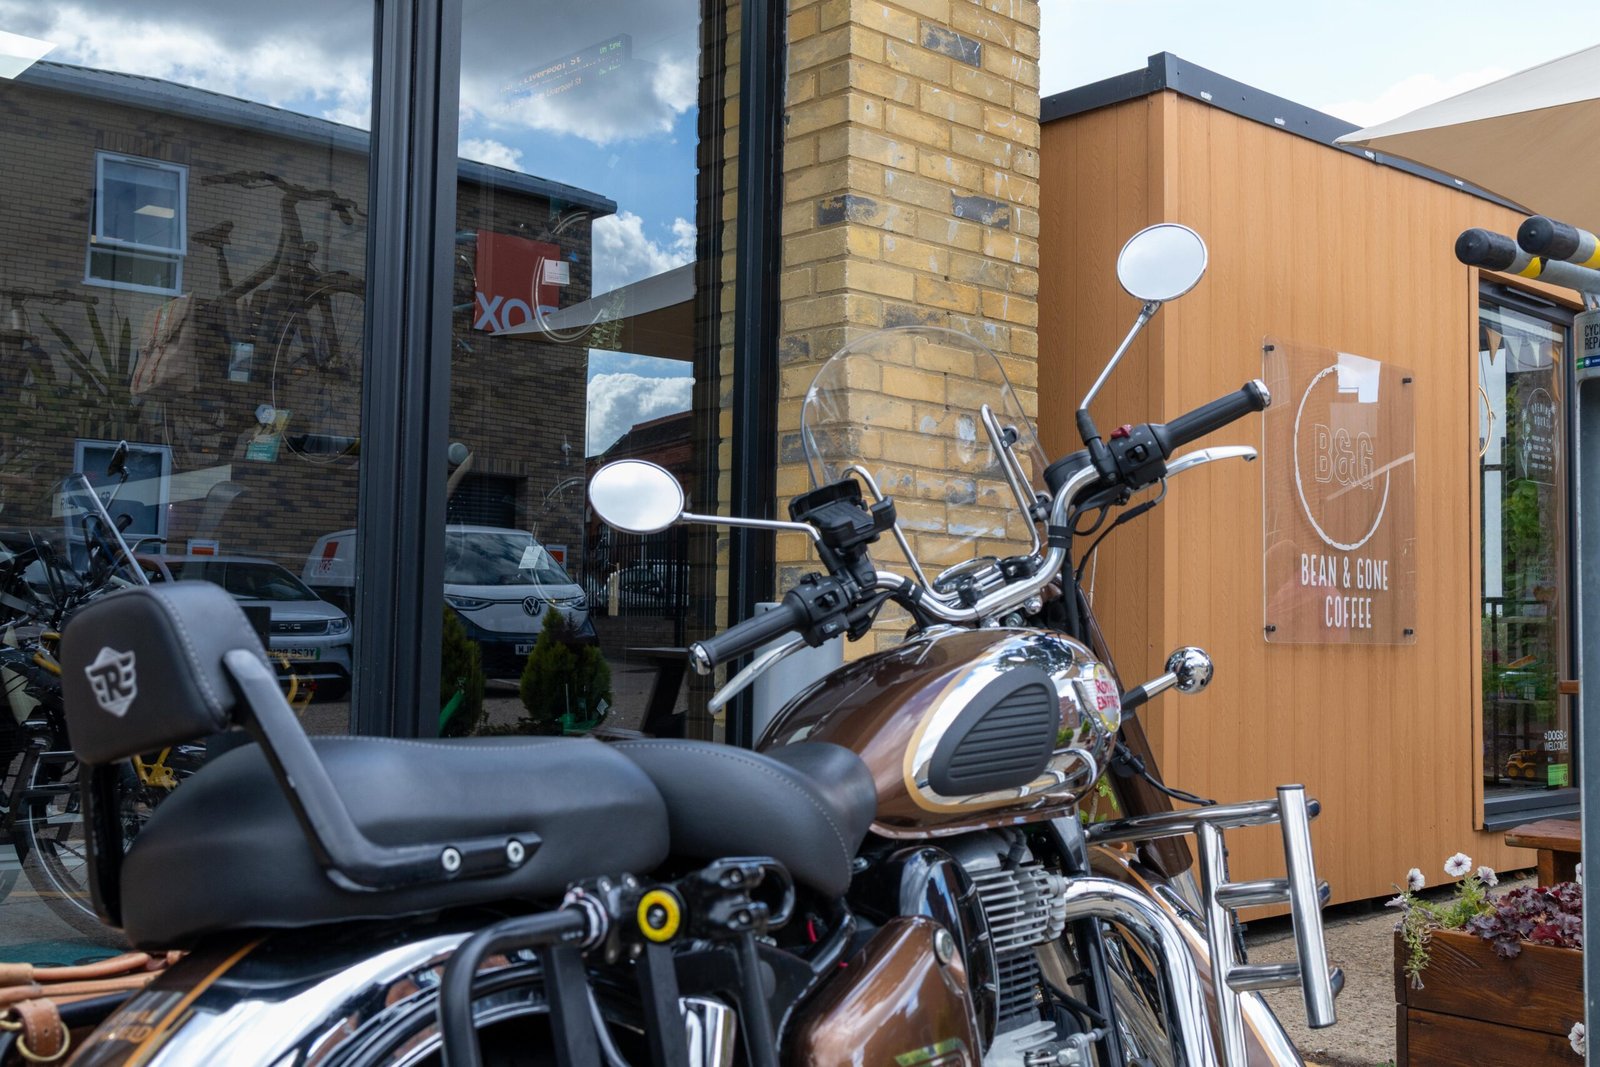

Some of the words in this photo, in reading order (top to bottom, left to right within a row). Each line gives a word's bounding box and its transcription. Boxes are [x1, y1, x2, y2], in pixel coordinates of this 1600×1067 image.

[1584, 324, 1600, 336] CYC
[1301, 553, 1337, 587] BEAN
[1343, 556, 1351, 588] &
[1357, 557, 1388, 591] GONE
[1325, 595, 1372, 629] COFFEE
[1547, 730, 1564, 741] DOGS
[1544, 741, 1568, 752] WELCOME
